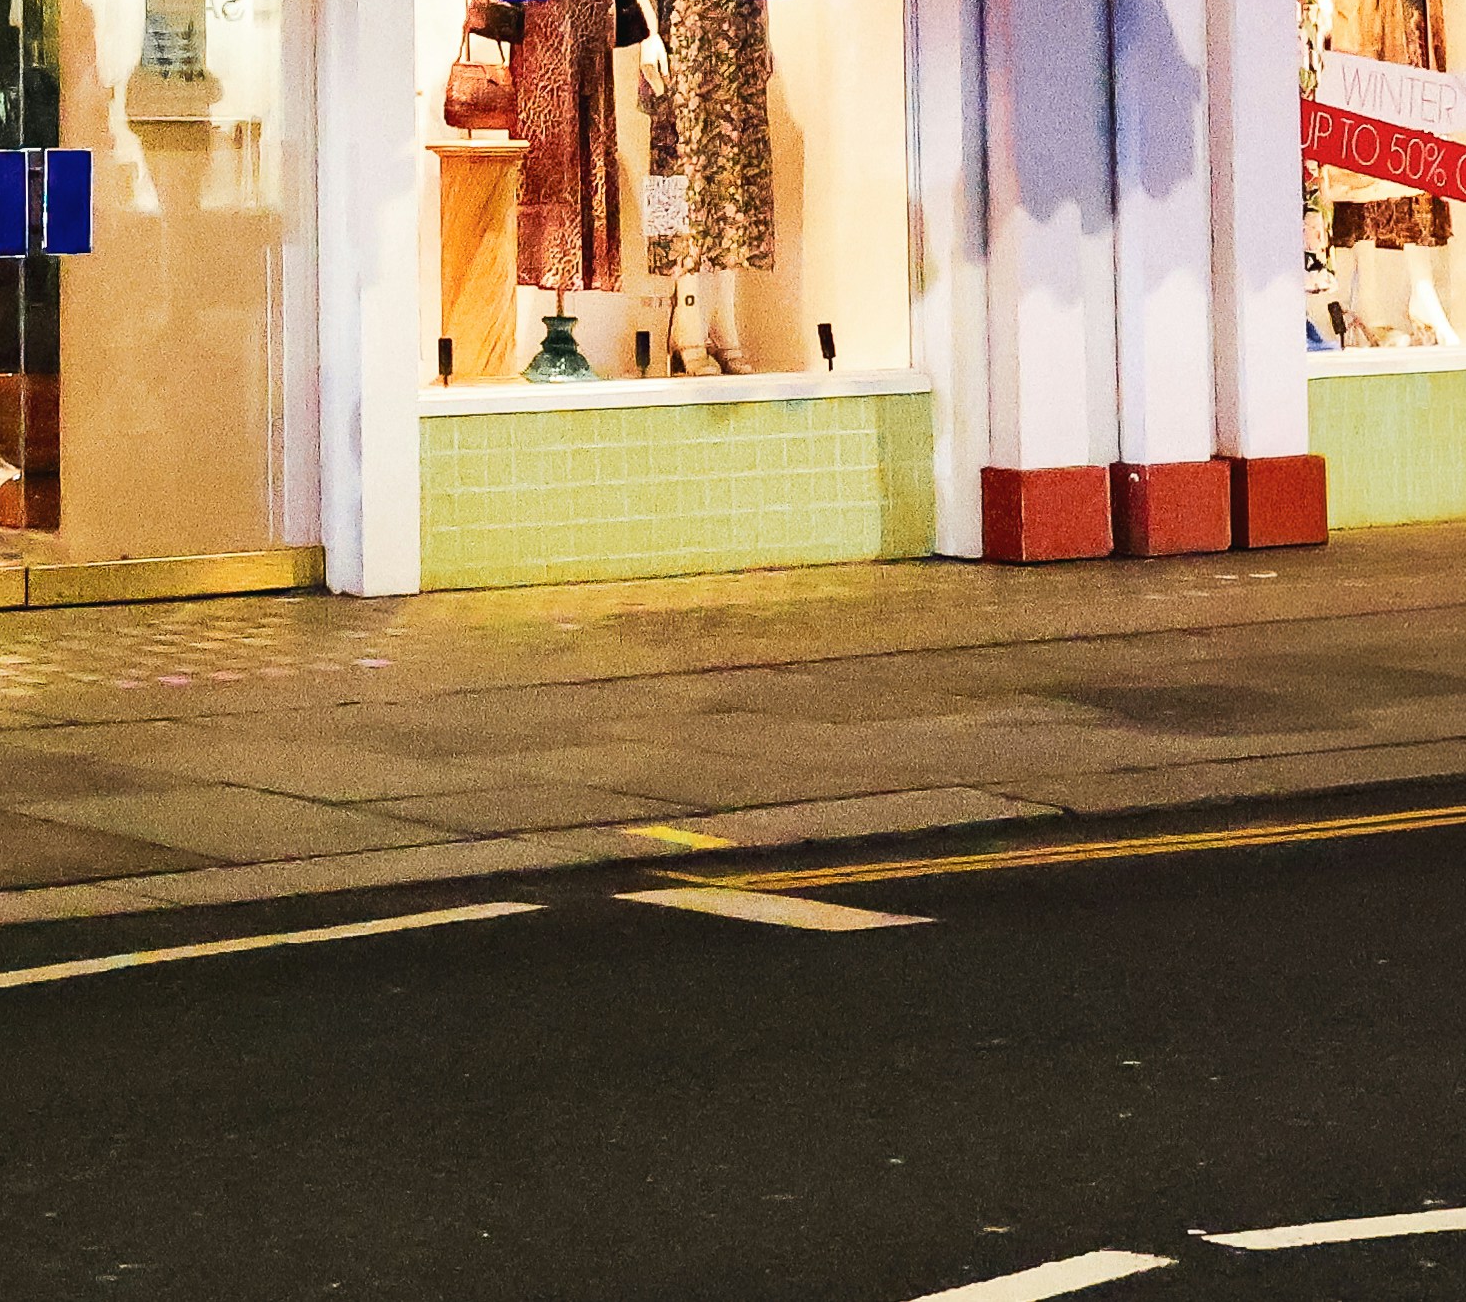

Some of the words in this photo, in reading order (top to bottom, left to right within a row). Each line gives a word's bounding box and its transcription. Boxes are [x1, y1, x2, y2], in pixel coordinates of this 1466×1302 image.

[1340, 64, 1458, 126] WINTER
[1340, 117, 1381, 166] TO
[1387, 133, 1448, 187] 50%
